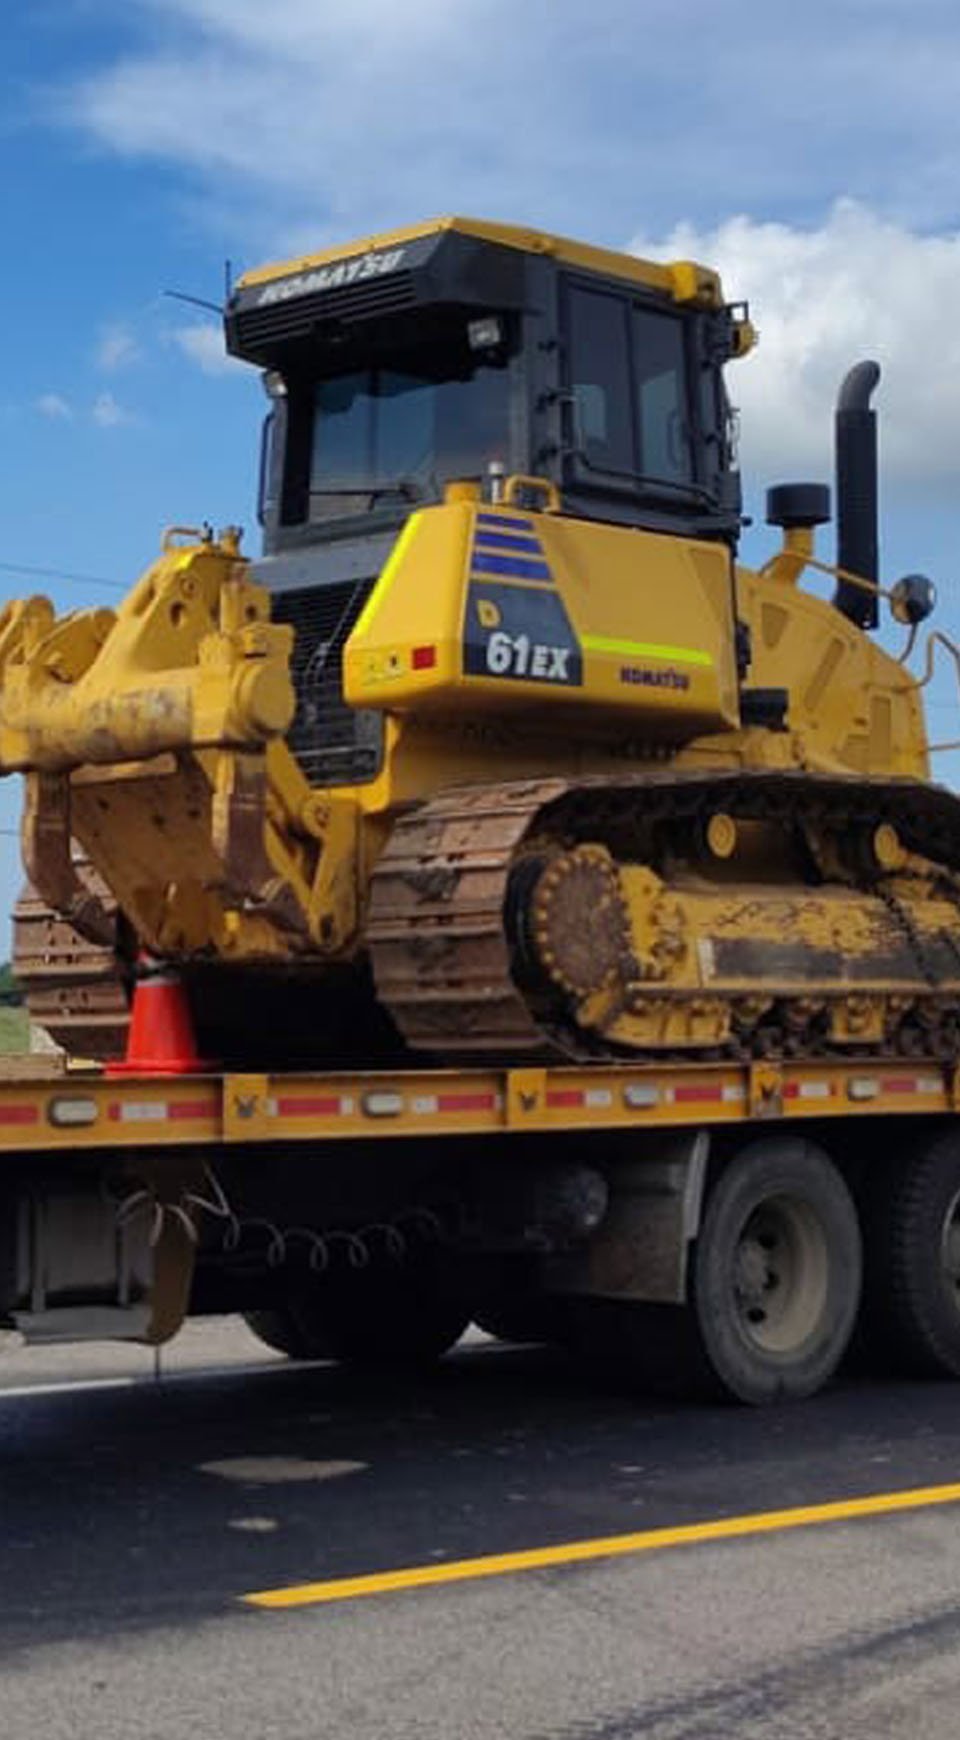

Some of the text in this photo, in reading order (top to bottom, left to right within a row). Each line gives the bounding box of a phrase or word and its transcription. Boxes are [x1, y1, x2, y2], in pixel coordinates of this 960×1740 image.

[257, 249, 406, 305] KOMATSU
[477, 599, 501, 628] D
[620, 666, 690, 690] KOMATSU
